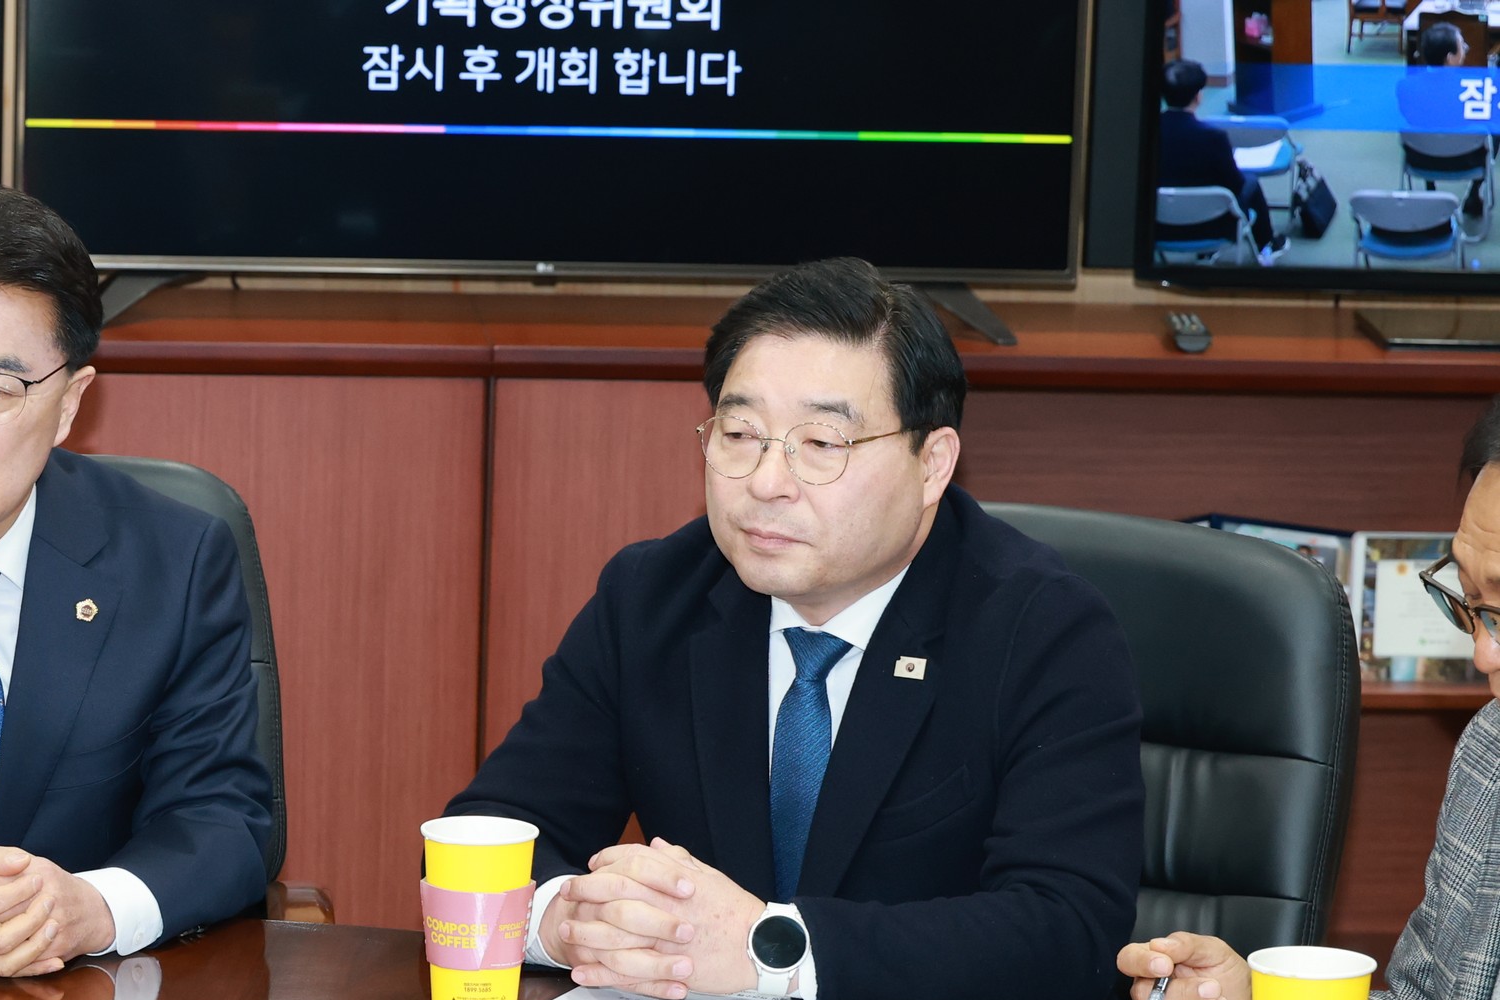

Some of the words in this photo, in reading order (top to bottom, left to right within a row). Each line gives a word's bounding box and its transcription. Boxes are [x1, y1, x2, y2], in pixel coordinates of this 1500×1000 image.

[362, 44, 444, 92] 잠시
[459, 44, 502, 93] 후
[514, 46, 598, 95] 개회
[613, 47, 743, 97] 합니다
[1458, 76, 1500, 120] 잠
[426, 916, 488, 936] COMPOSE
[431, 931, 478, 949] COFFEE
